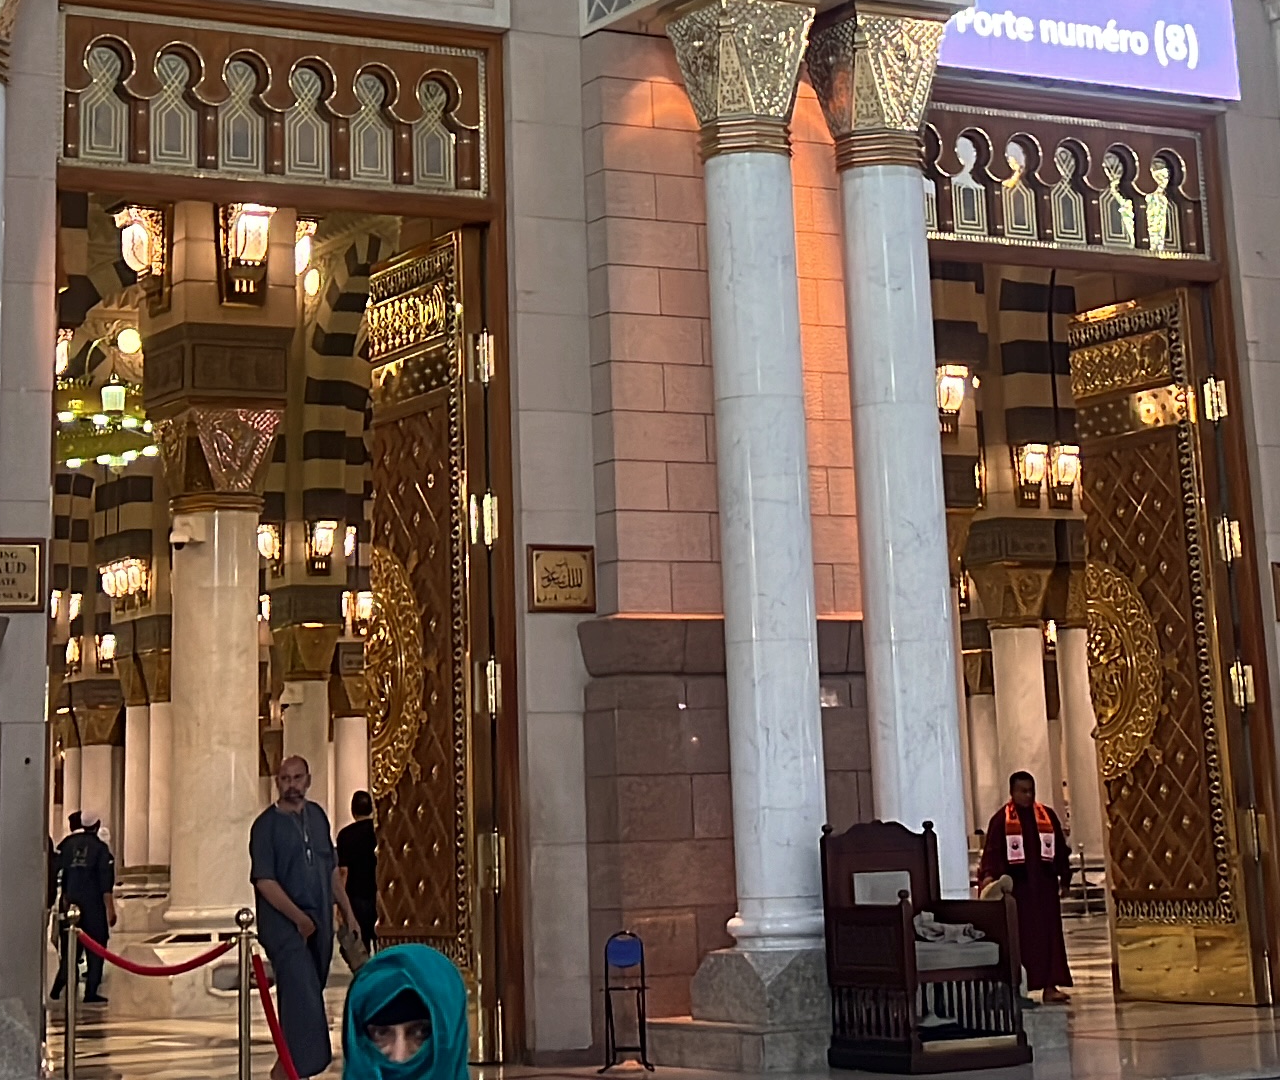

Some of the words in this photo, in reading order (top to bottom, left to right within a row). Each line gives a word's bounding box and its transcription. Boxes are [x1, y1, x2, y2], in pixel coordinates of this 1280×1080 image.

[956, 7, 1034, 42] Porte
[1039, 19, 1149, 55] numéro
[1154, 20, 1198, 69] (8)
